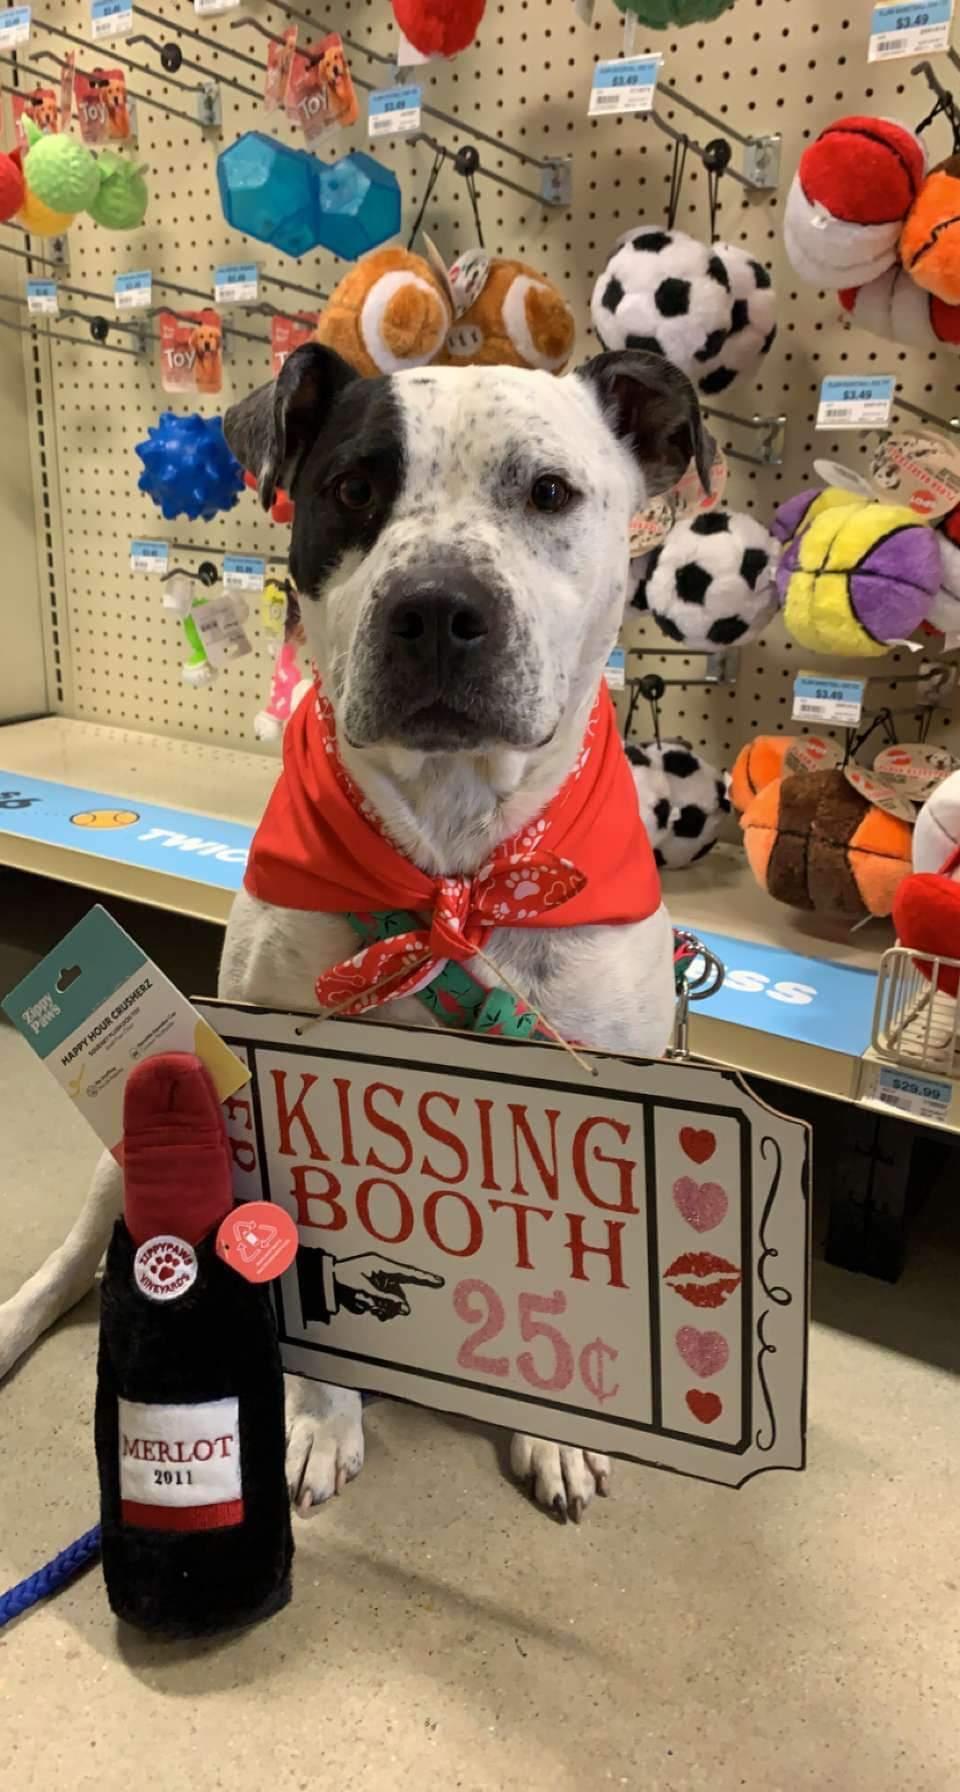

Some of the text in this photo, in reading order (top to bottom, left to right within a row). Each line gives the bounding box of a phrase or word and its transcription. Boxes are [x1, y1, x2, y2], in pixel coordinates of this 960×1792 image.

[896, 13, 929, 30] $3.49
[612, 74, 639, 87] $3.49
[164, 348, 196, 369] Toy
[843, 389, 873, 401] $3.49
[816, 689, 844, 700] $3.49
[137, 828, 250, 867] TWIC
[61, 1038, 89, 1066] HAPPY
[87, 1017, 113, 1041] HOUR
[110, 978, 153, 1020] CRUSHERZ
[893, 1079, 940, 1099] $29.99
[270, 1069, 640, 1215] KISSING
[290, 1166, 631, 1290] BOOTH
[139, 1242, 193, 1266] ZIPPYPAWS
[139, 1273, 190, 1294] VINEYARDS
[452, 1278, 620, 1403] 25¢
[123, 1435, 234, 1463] MERLOT
[154, 1469, 194, 1486] 2011
